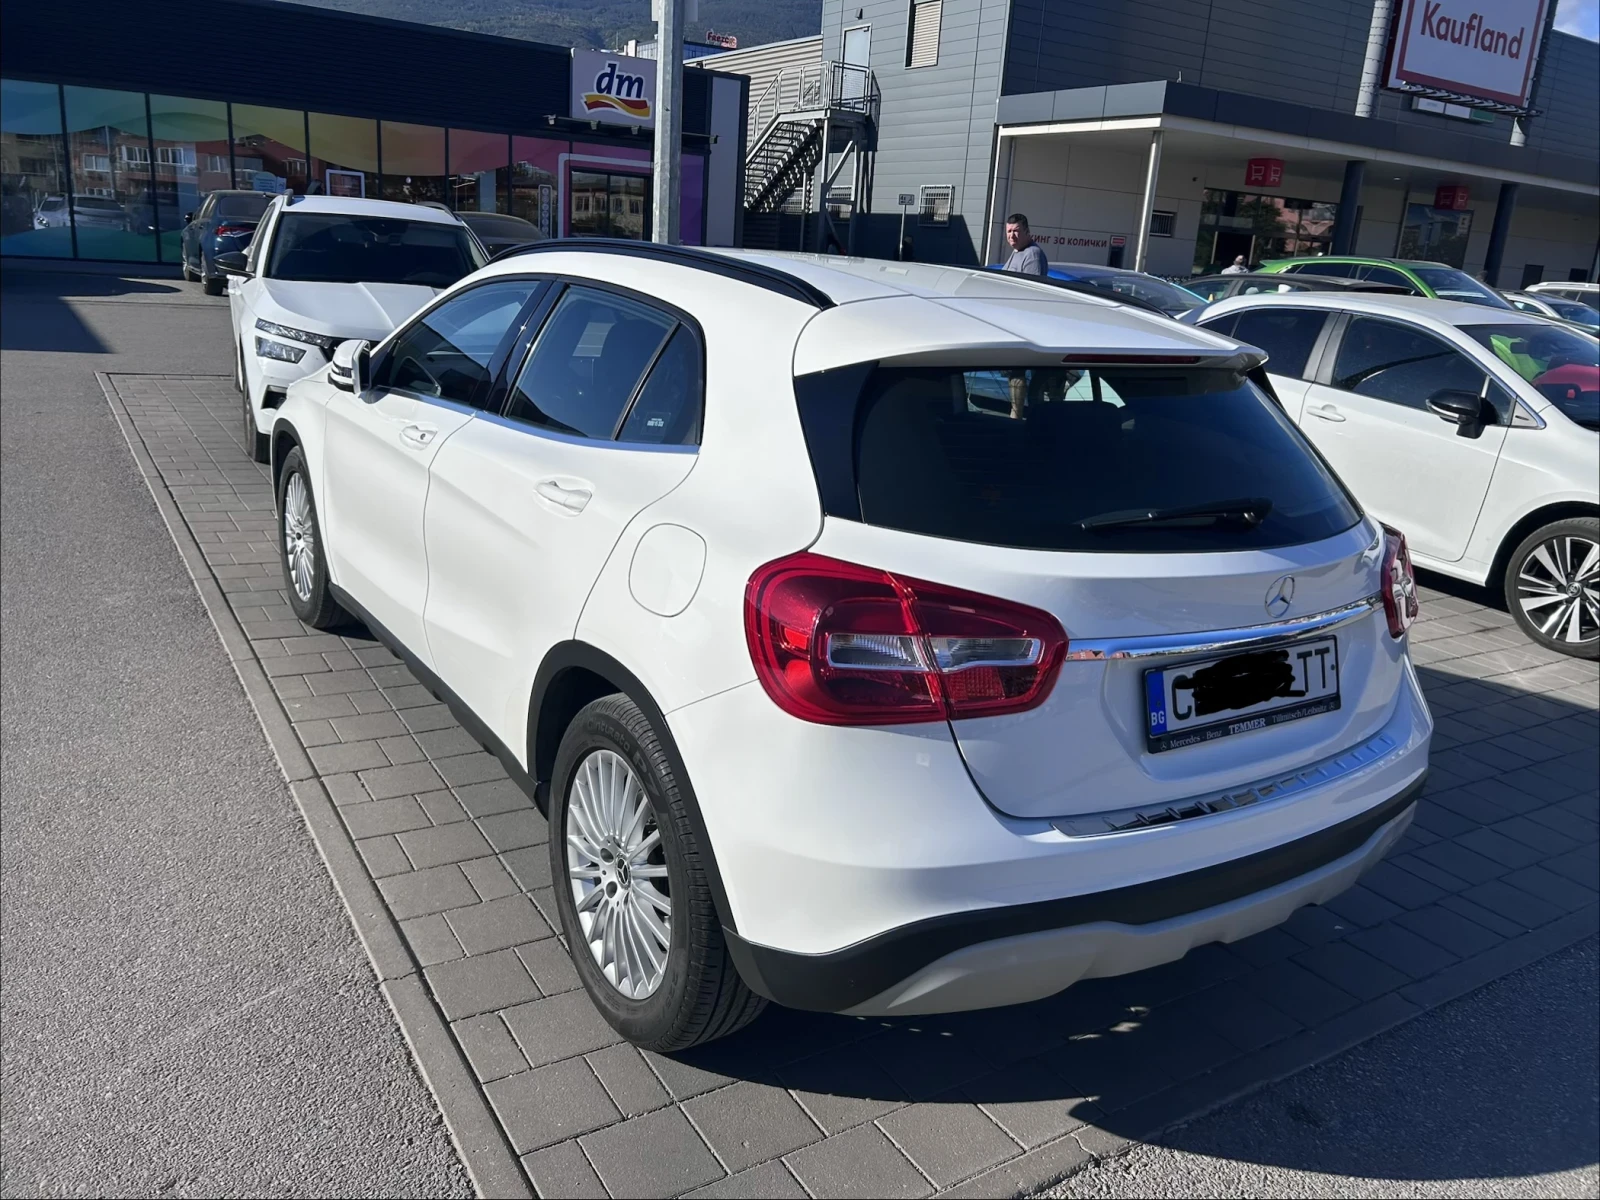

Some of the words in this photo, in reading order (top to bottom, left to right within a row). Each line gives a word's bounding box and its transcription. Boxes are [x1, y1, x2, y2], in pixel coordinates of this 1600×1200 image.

[1420, 0, 1525, 60] Kaufland
[596, 63, 644, 99] dm
[1053, 236, 1065, 245] за
[1067, 237, 1107, 248] колички
[1151, 710, 1165, 726] BG
[1170, 733, 1201, 749] Mercedes
[1206, 730, 1222, 741] Benz
[1228, 717, 1266, 735] TEMMER
